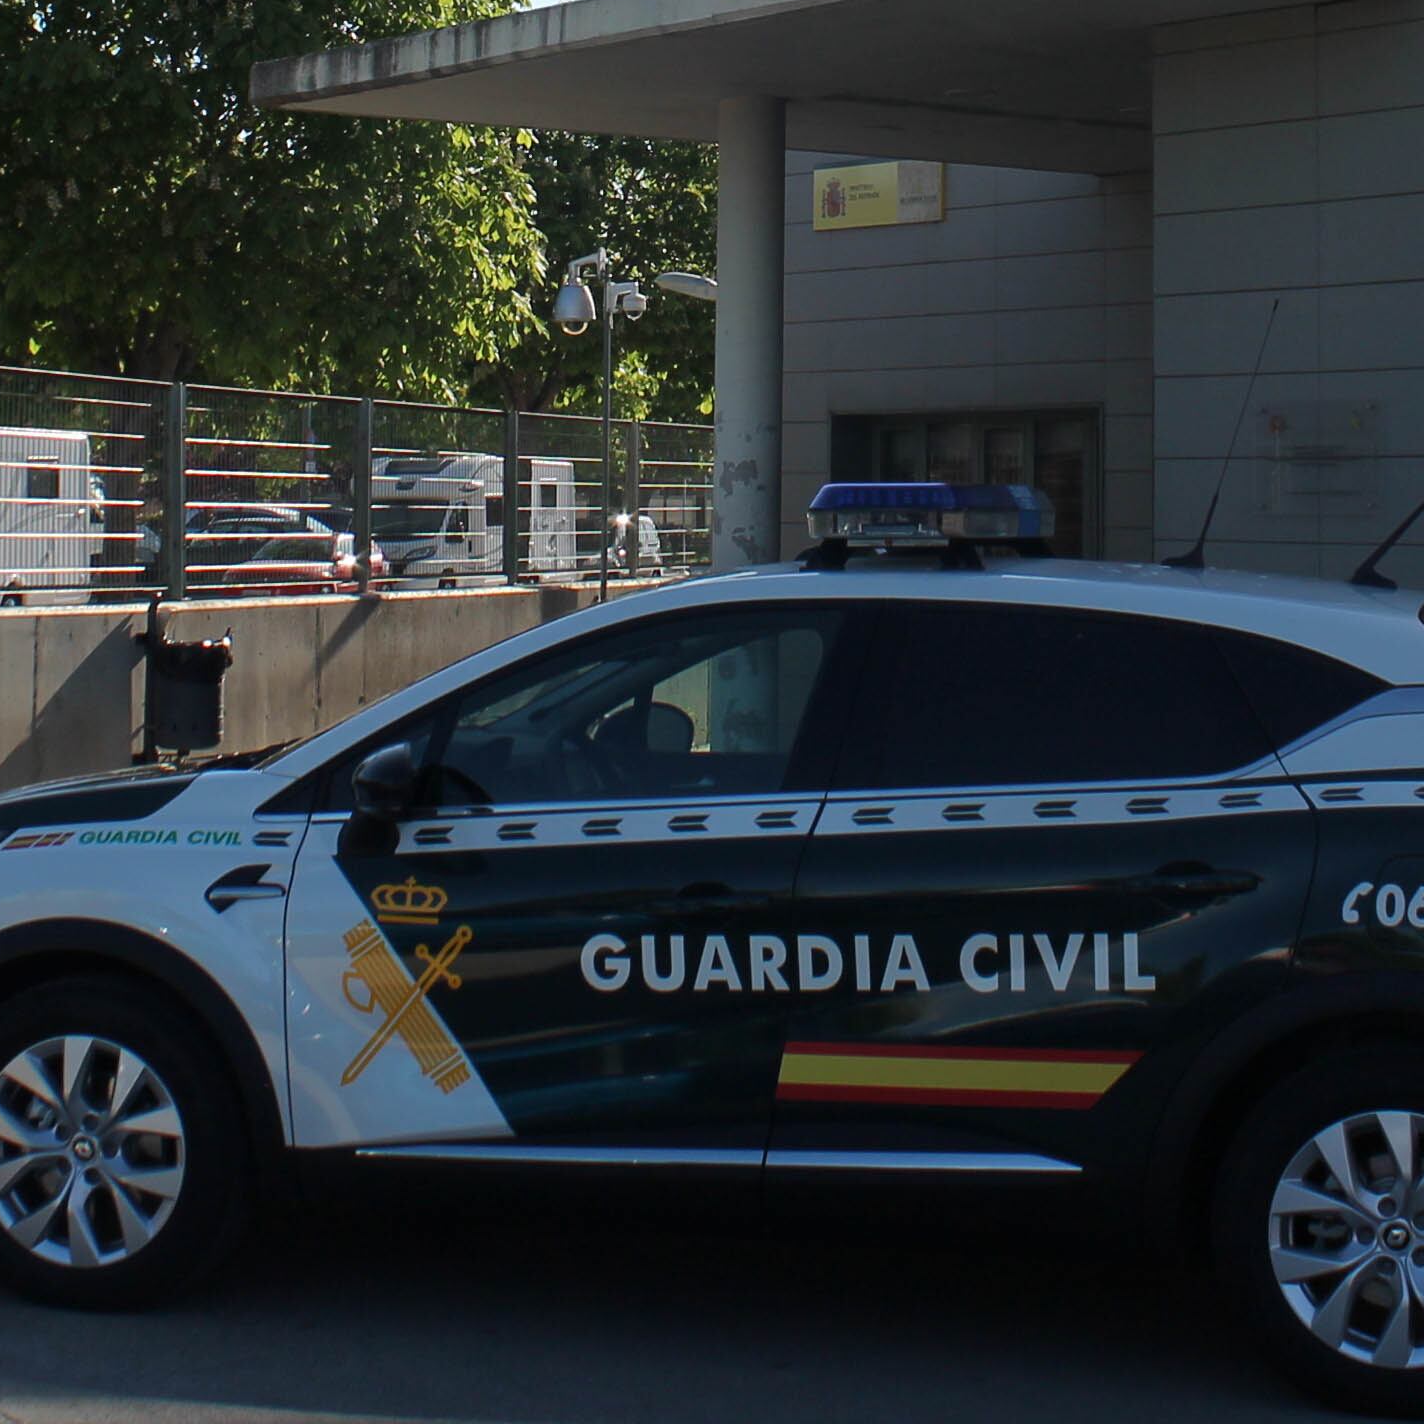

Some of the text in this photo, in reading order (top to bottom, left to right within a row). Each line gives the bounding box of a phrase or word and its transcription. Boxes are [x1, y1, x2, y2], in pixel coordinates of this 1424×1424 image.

[78, 830, 242, 845] GUARDIA CIVIL
[579, 932, 1157, 992] GUARDIA CIVIL
